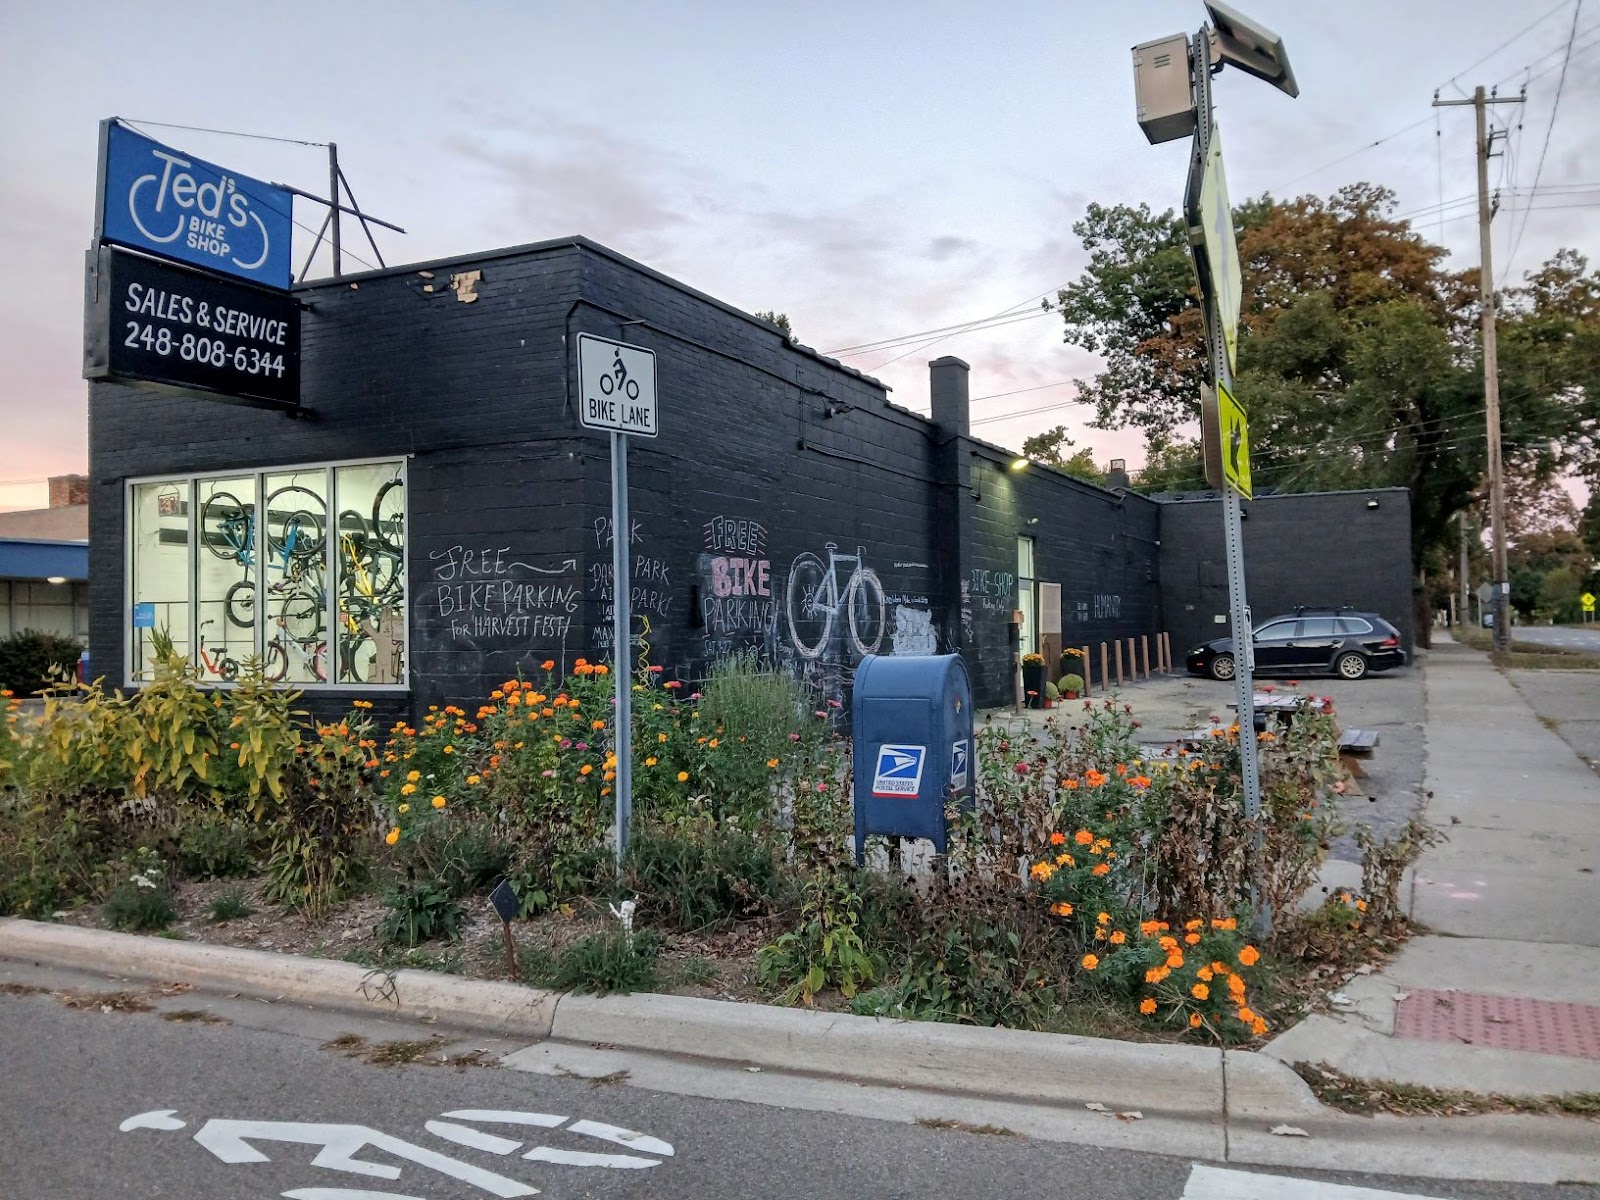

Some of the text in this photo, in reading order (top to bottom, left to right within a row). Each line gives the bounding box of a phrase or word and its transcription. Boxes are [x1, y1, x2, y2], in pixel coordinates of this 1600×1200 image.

[153, 149, 248, 227] Ted's
[186, 232, 231, 258] SHOP
[189, 215, 226, 241] BIKE
[125, 282, 288, 346] SALES & SERVICE
[124, 321, 286, 379] 248-808-6344
[589, 398, 651, 428] BIKE LANE
[711, 515, 760, 555] FREE
[429, 546, 511, 580] FREE
[634, 555, 670, 586] PARK
[711, 556, 771, 598] BIKE
[437, 584, 496, 617] BIKE
[502, 580, 582, 614] PARKING
[994, 571, 1014, 597] SHOP
[474, 613, 530, 638] HARVEST
